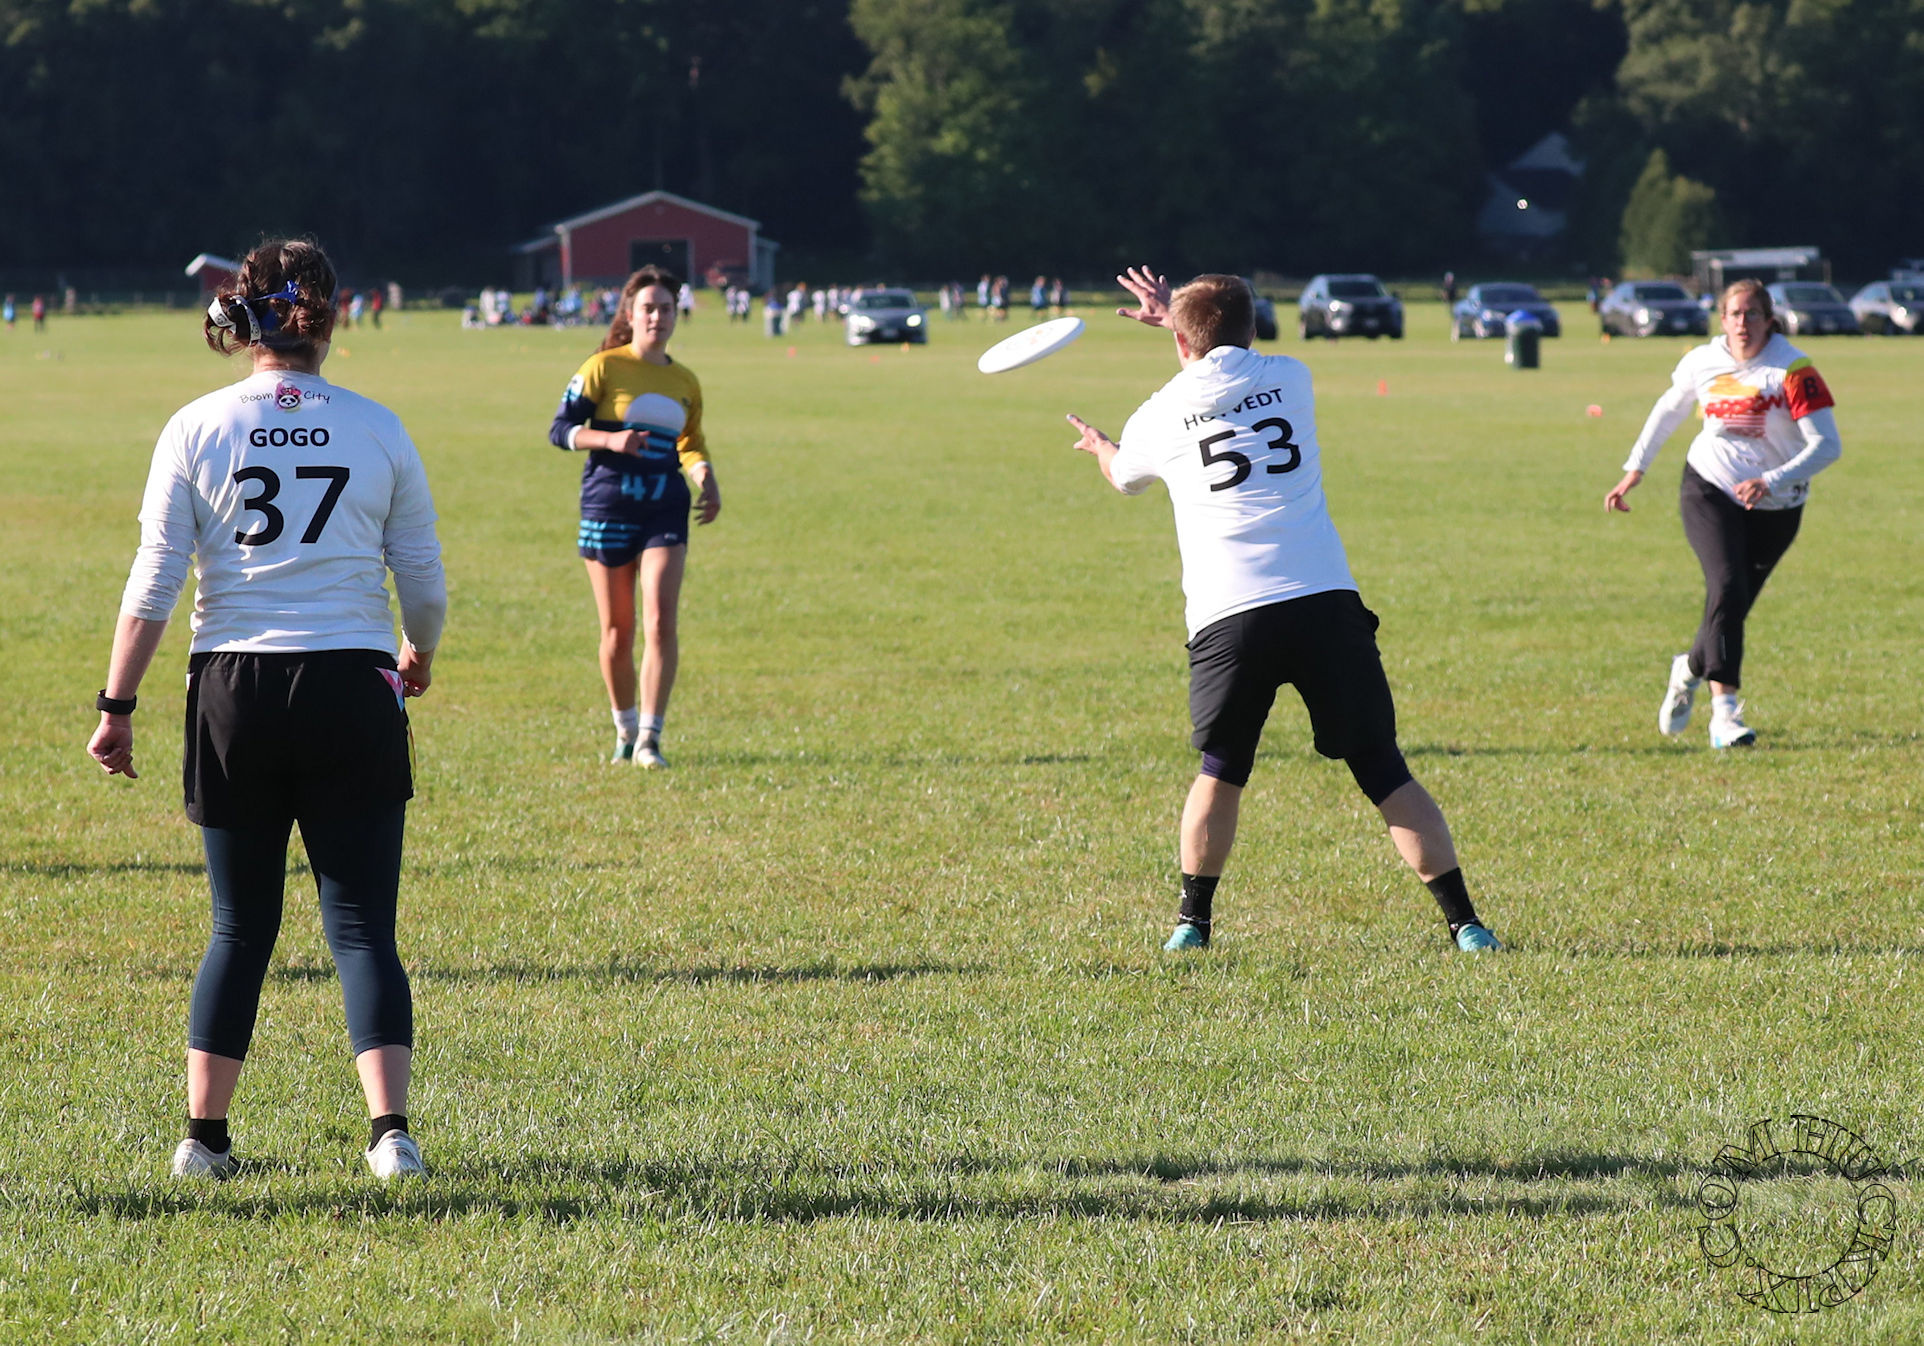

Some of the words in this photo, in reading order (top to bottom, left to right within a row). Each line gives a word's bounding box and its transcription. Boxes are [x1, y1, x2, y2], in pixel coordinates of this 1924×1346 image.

[240, 392, 272, 404] Boom
[303, 390, 331, 404] City
[1802, 376, 1819, 398] B
[249, 427, 331, 448] GOGO
[1198, 416, 1302, 492] 53
[620, 473, 668, 501] 47
[232, 465, 351, 547] 37
